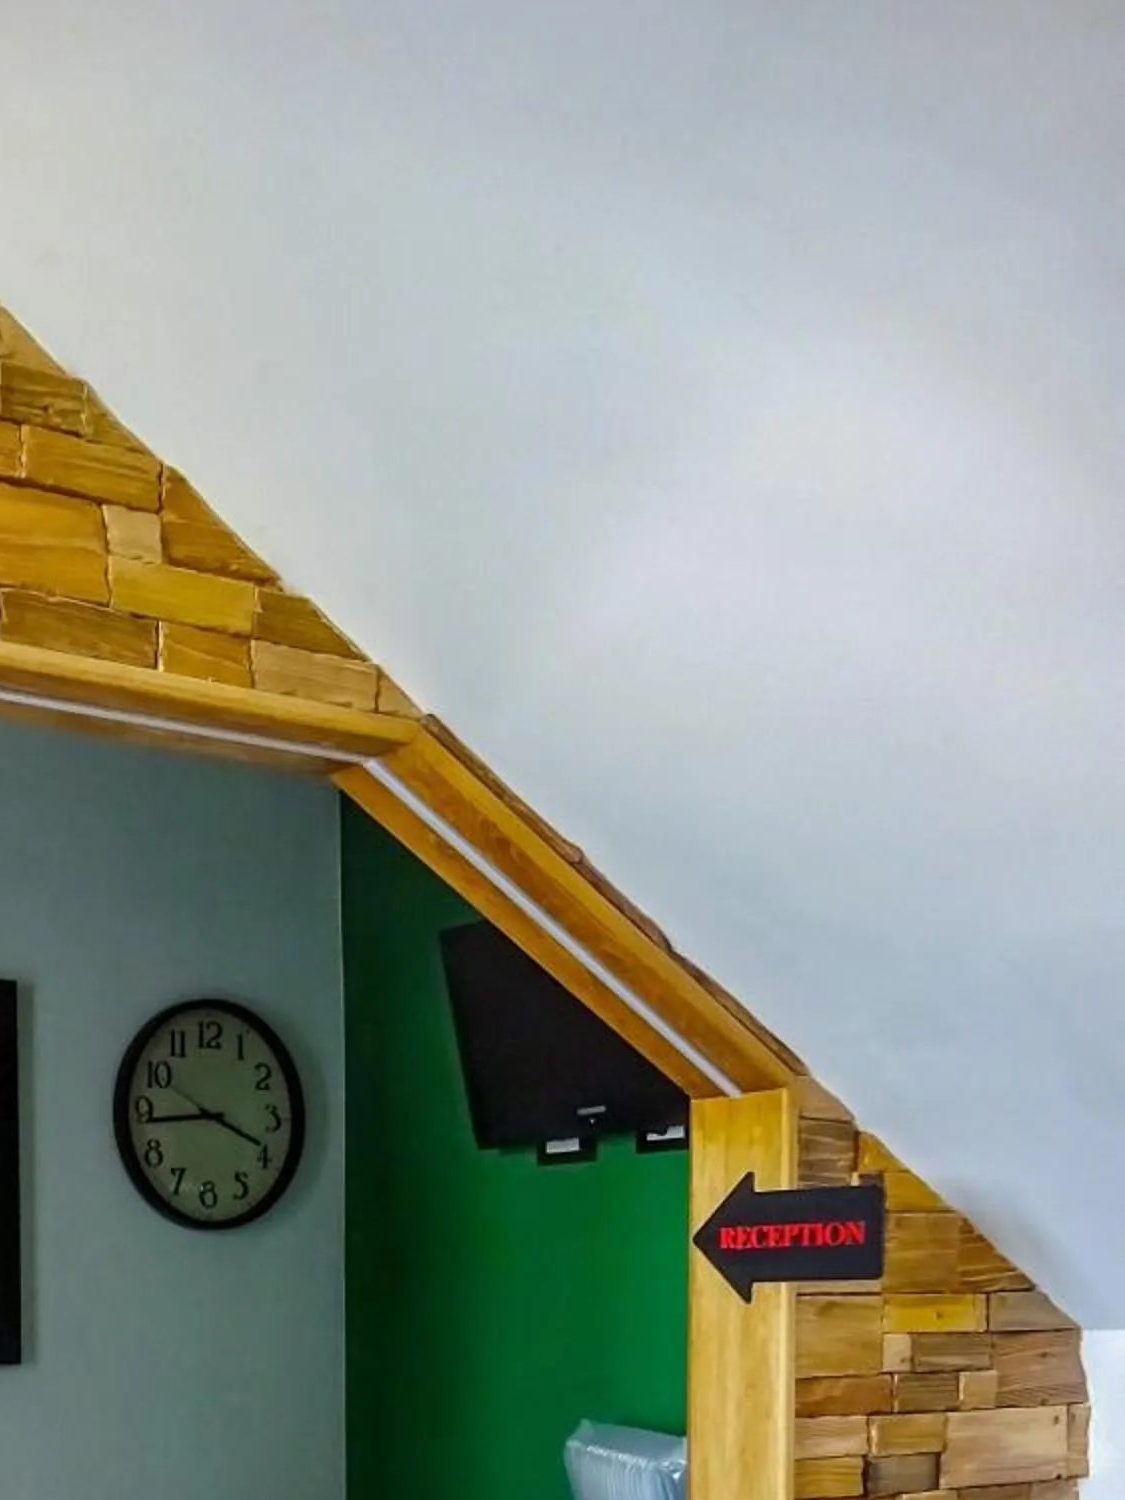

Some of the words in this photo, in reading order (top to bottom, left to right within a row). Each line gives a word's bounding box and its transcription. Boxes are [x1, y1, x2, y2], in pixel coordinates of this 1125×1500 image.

[170, 1029, 187, 1059] 11
[197, 1020, 223, 1050] 12
[235, 1033, 245, 1061] 1
[146, 1060, 173, 1089] 10
[253, 1062, 272, 1091] 2
[134, 1095, 154, 1124] 9
[264, 1103, 282, 1133] 3
[143, 1138, 164, 1168] 8
[256, 1143, 273, 1170] 4
[170, 1167, 187, 1196] 7
[198, 1180, 218, 1209] 6
[232, 1171, 249, 1200] 5
[718, 1221, 866, 1249] RECEPTION
